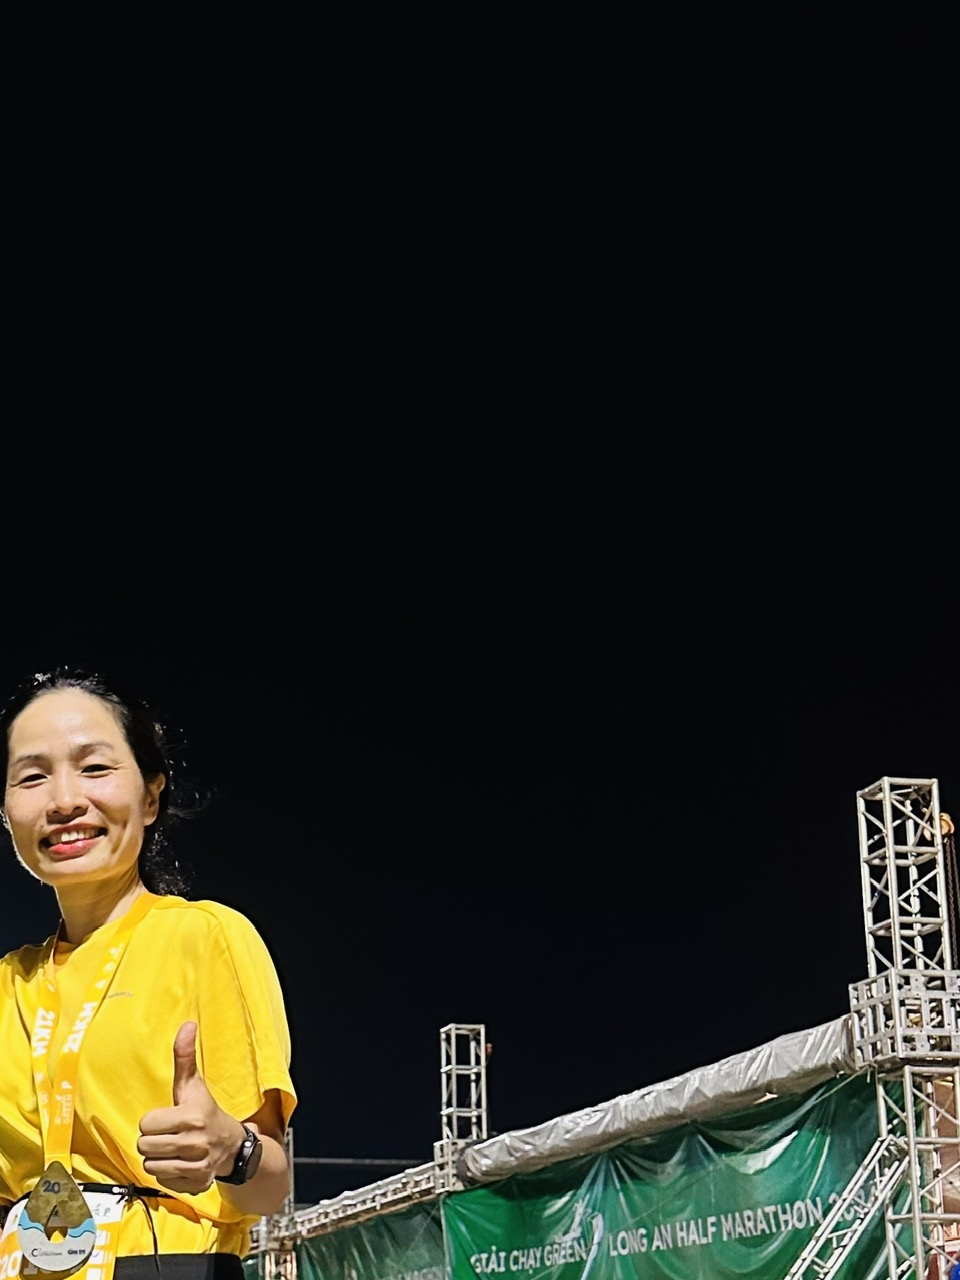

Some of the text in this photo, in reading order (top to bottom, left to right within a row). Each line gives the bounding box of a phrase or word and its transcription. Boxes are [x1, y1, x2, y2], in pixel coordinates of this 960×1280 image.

[32, 1006, 55, 1058] 21KM
[62, 1001, 98, 1054] 21KM
[43, 1179, 61, 1194] 20
[469, 1245, 507, 1274] GIẢI
[509, 1246, 543, 1275] CHẠY
[543, 1239, 587, 1267] GREEN
[608, 1227, 648, 1257] LONG
[651, 1224, 672, 1251] AN
[676, 1216, 717, 1248] HALF
[721, 1196, 823, 1241] MARATHON
